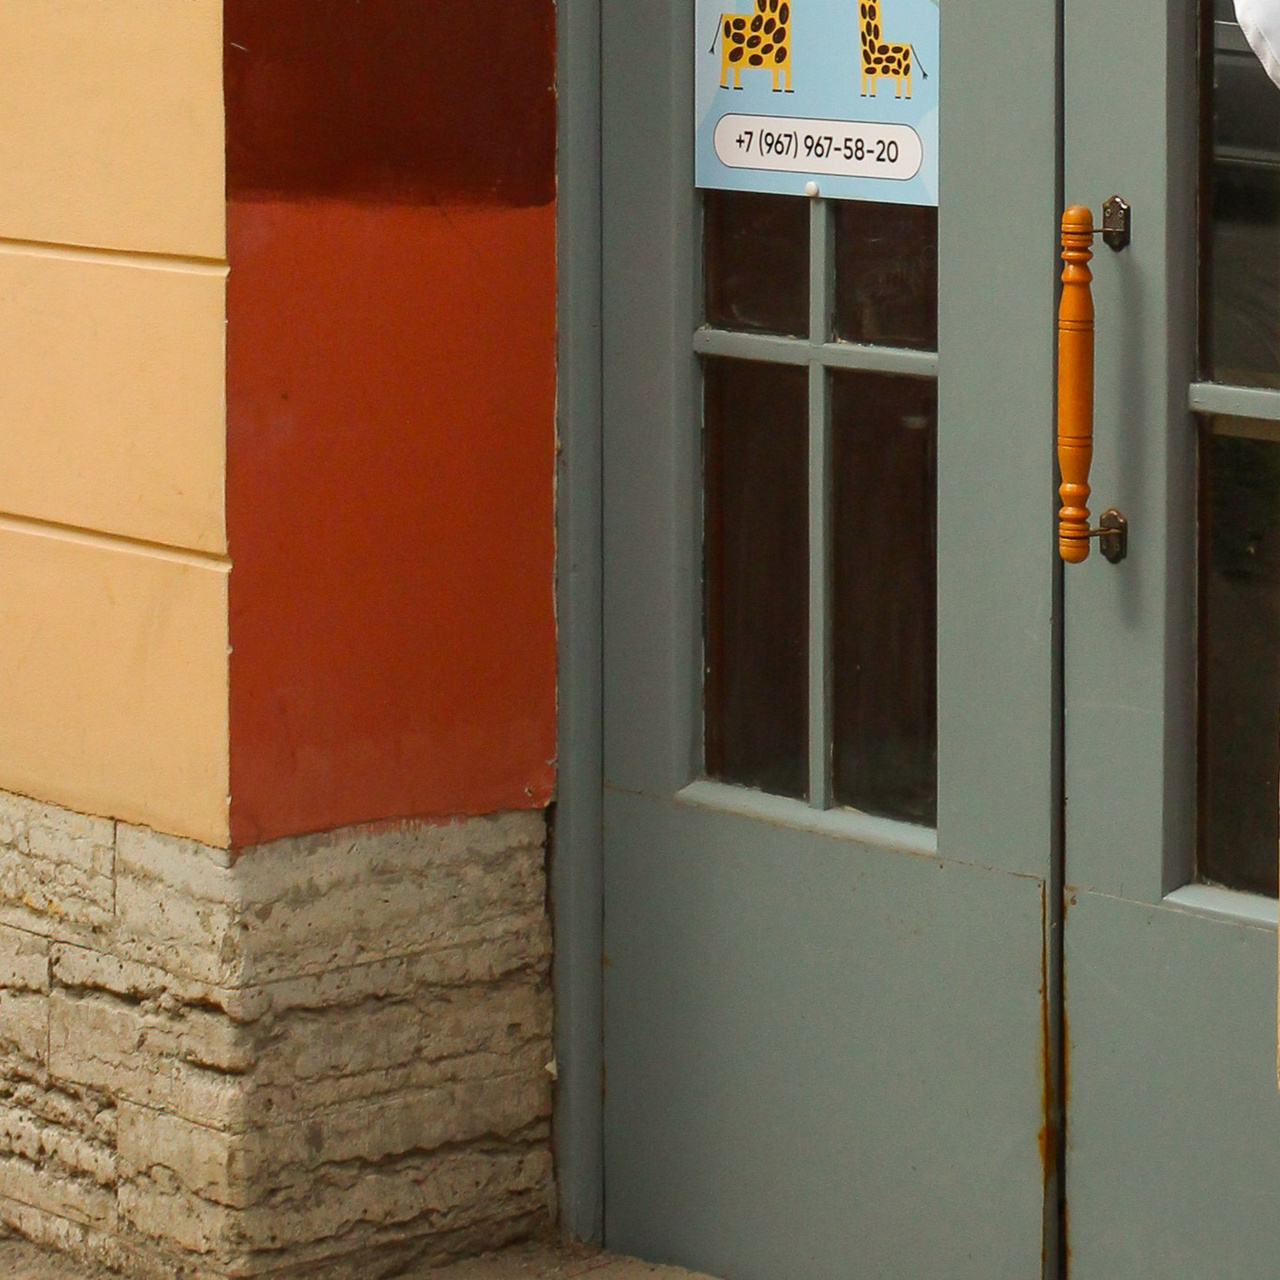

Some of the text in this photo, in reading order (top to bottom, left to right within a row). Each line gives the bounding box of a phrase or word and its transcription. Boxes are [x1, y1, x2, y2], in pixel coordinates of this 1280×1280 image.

[735, 129, 899, 163] +7 (967) 967-58-20
